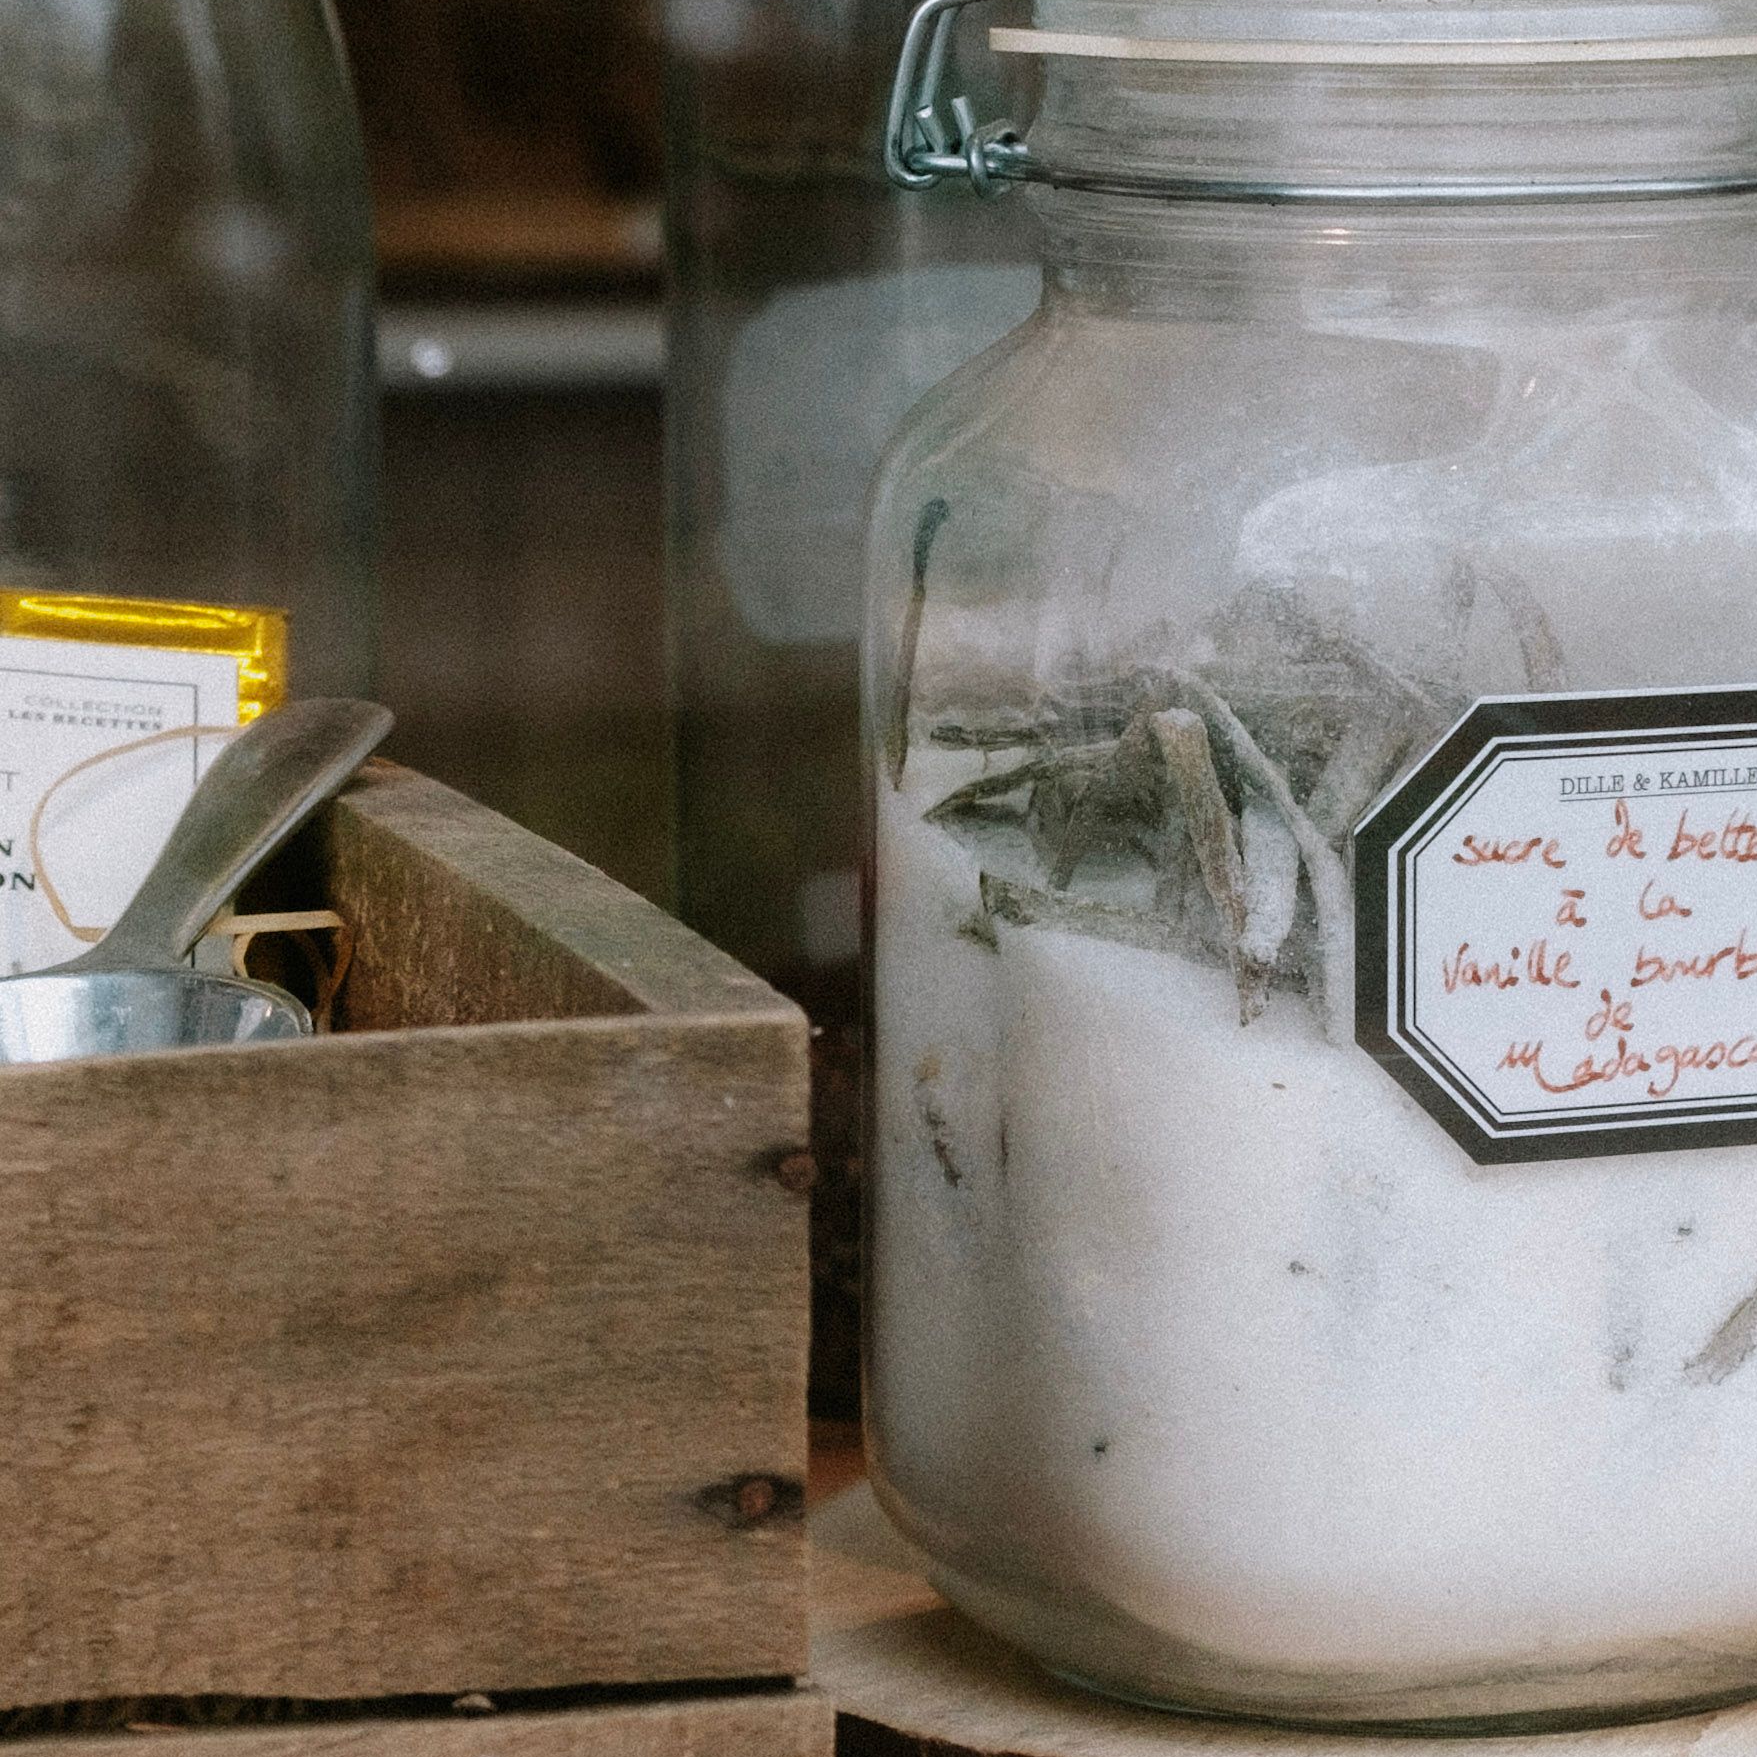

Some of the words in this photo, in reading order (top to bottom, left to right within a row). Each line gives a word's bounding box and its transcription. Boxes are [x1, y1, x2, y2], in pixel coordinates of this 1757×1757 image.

[1560, 774, 1625, 796] DILLE
[1633, 772, 1651, 792] &
[1606, 797, 1647, 859] de
[1585, 988, 1635, 1042] de
